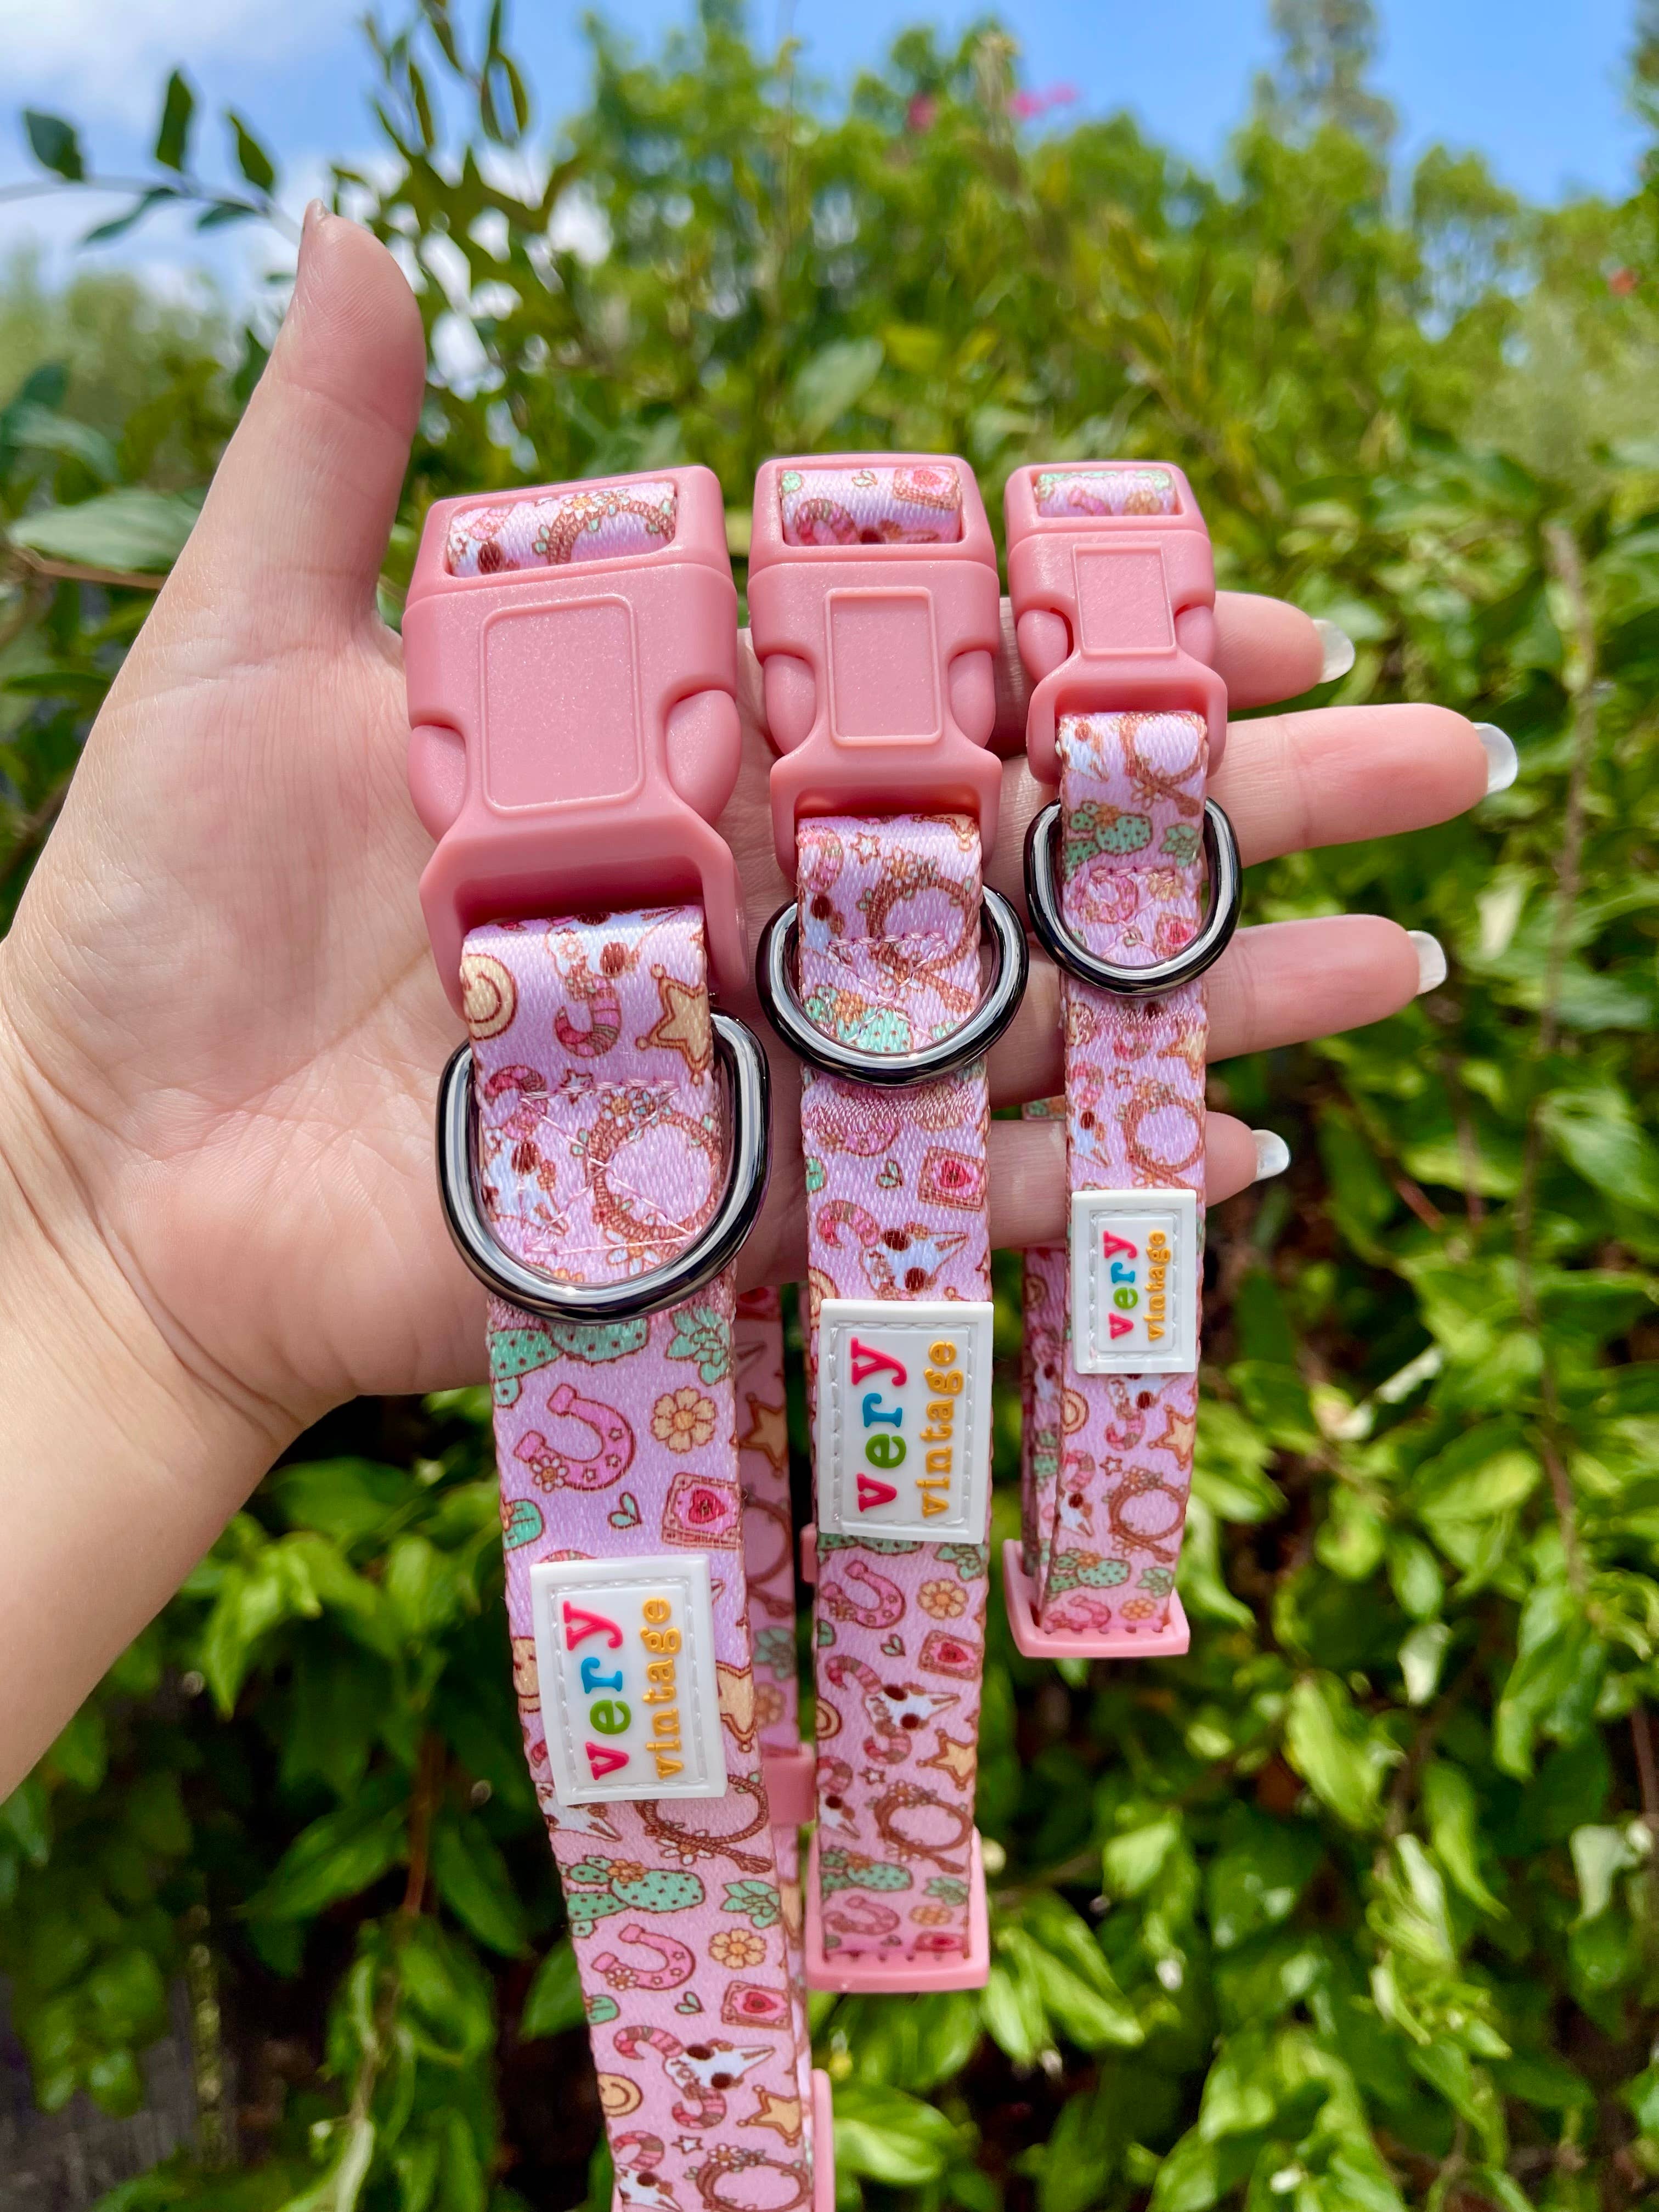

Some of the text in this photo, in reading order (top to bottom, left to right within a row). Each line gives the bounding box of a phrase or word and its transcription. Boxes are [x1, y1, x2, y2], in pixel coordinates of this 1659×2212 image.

[1103, 1230, 1138, 1339] very
[1143, 1230, 1171, 1342] vintage
[850, 1337, 907, 1513] very
[917, 1340, 964, 1518] vintage
[563, 1600, 630, 1781] very
[640, 1597, 684, 1780] vintage
